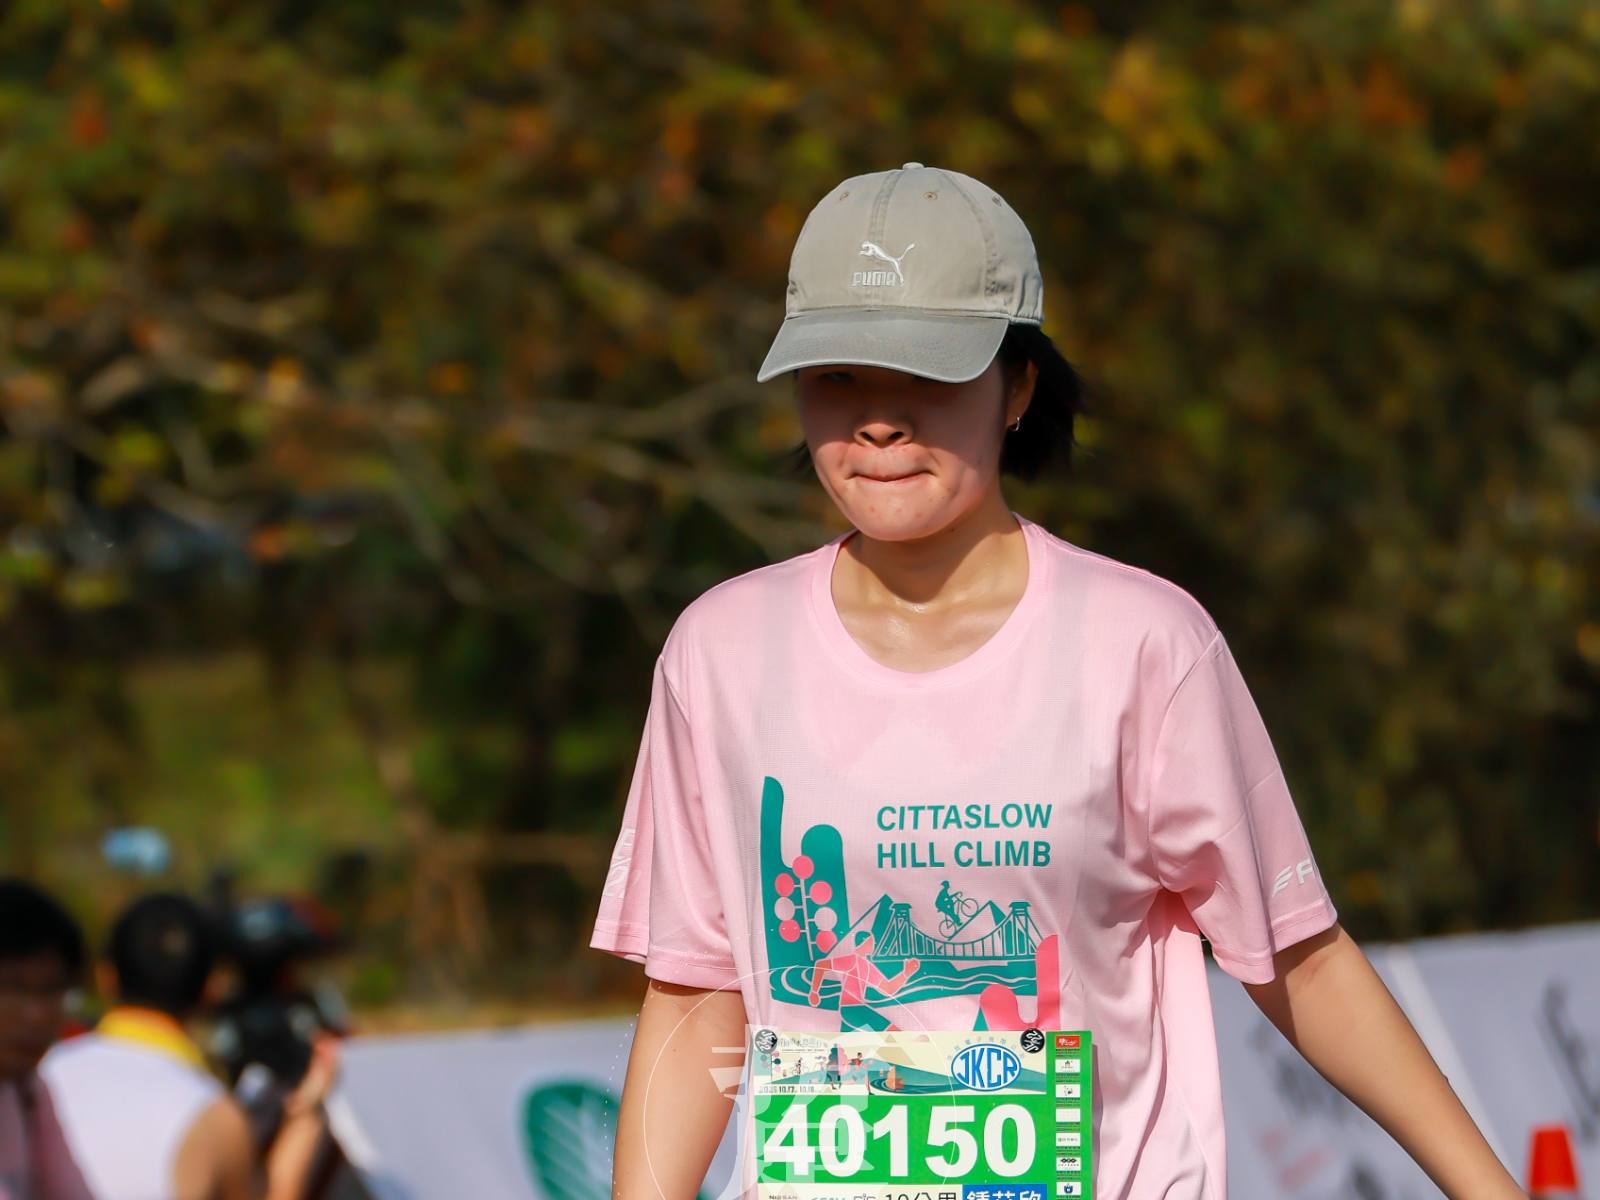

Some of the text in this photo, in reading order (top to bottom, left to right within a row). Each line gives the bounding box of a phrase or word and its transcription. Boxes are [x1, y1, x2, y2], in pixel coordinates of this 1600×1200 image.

[851, 271, 897, 287] PUMA
[876, 803, 1052, 831] CITTASLOW
[877, 840, 1051, 869] HILL CLIMB
[956, 1046, 1019, 1089] JKCR
[763, 1103, 1037, 1179] 40150
